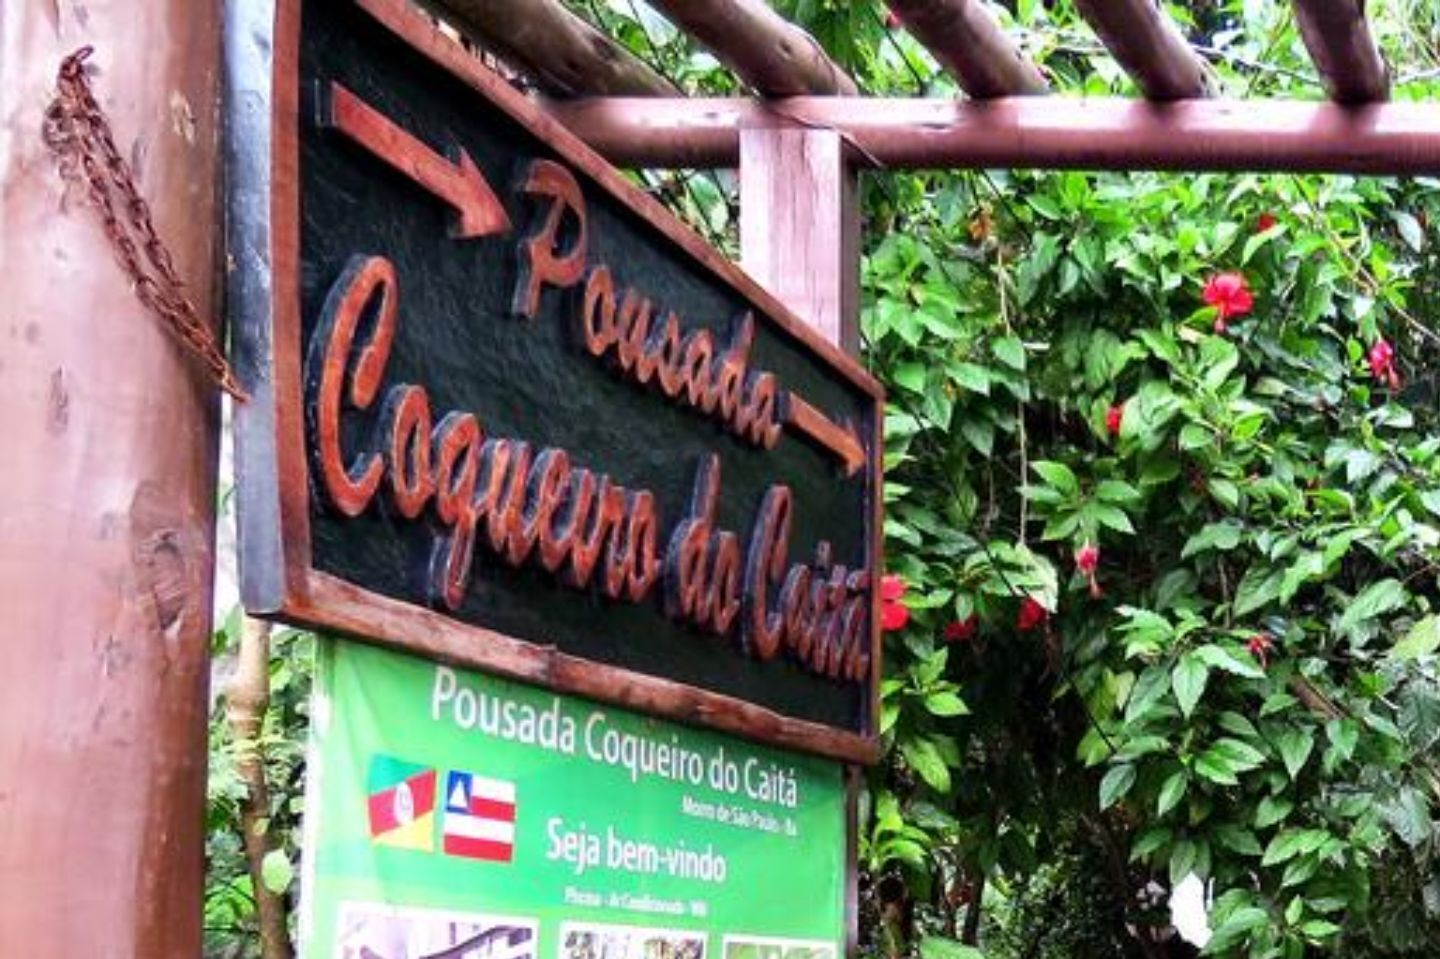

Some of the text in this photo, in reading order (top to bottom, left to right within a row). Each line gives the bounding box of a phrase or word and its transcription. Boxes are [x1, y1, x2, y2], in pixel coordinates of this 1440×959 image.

[511, 156, 784, 452] Pousada
[308, 254, 661, 610] Coqueiro
[431, 665, 798, 808] Pousada Coqueiro do Caitá
[546, 817, 727, 882] Seja bem-vindo
